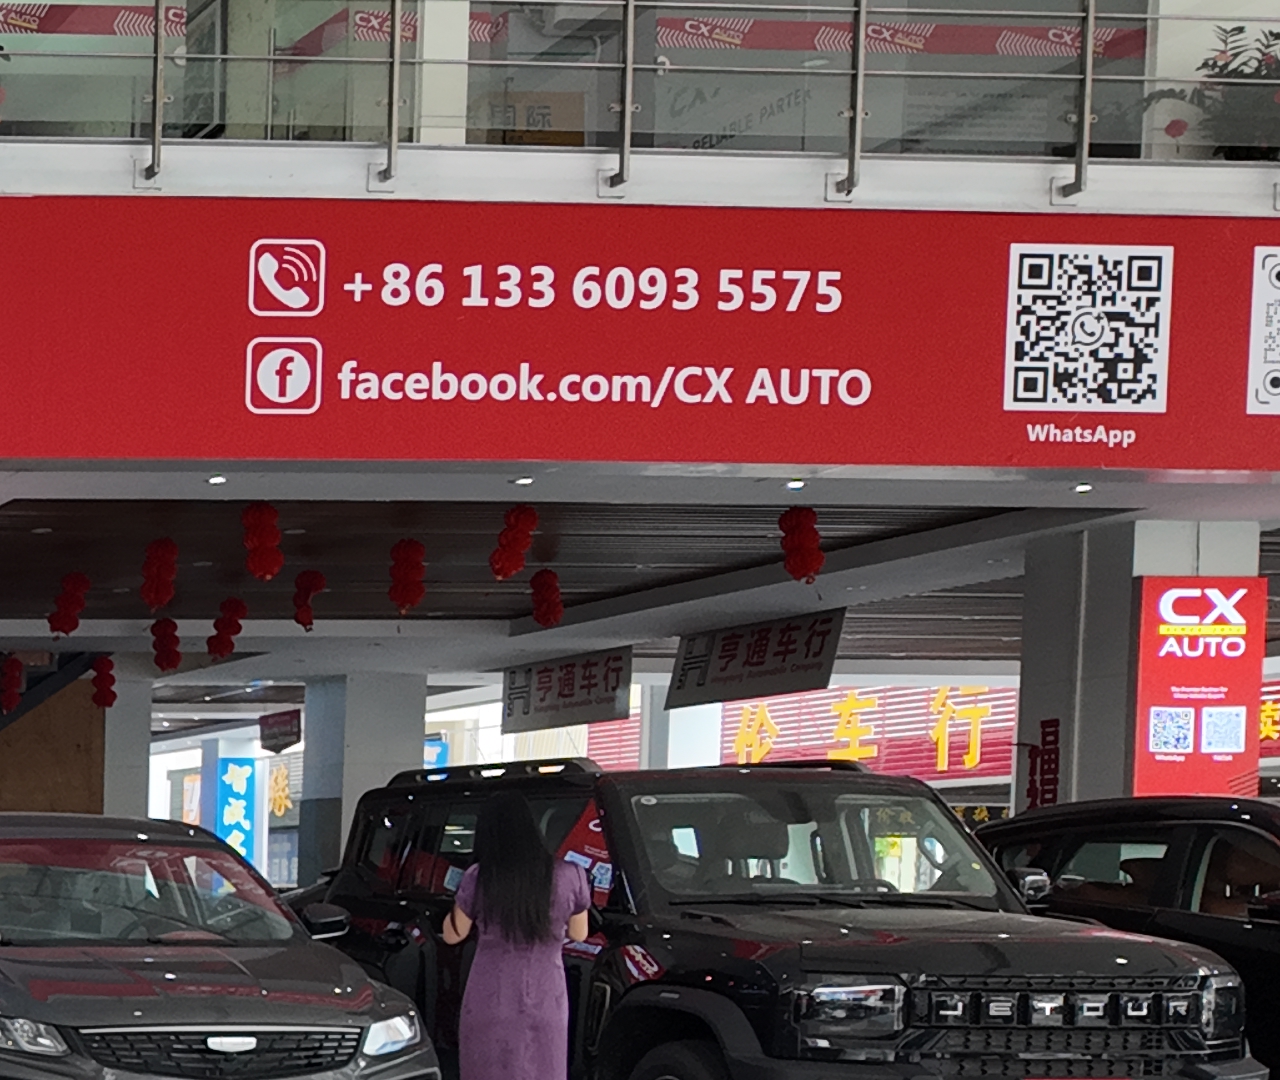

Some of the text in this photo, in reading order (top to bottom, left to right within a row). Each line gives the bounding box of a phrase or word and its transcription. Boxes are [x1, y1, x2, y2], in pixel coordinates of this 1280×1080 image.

[8, 12, 40, 26] AUTO
[354, 13, 383, 30] CX
[684, 20, 744, 42] CX AUTO
[867, 25, 926, 47] CX AUTO
[1048, 28, 1075, 45] CX
[343, 262, 843, 313] +86 133 6093 5575
[338, 361, 872, 408] facebook.com/CX AUTO
[1026, 424, 1137, 448] WhatsApp
[1158, 588, 1248, 624] CX
[719, 617, 834, 672] 亨通车行
[1157, 637, 1247, 657] AUTO
[535, 655, 624, 702] 亨通车行
[939, 1000, 1189, 1017] JETOUR
